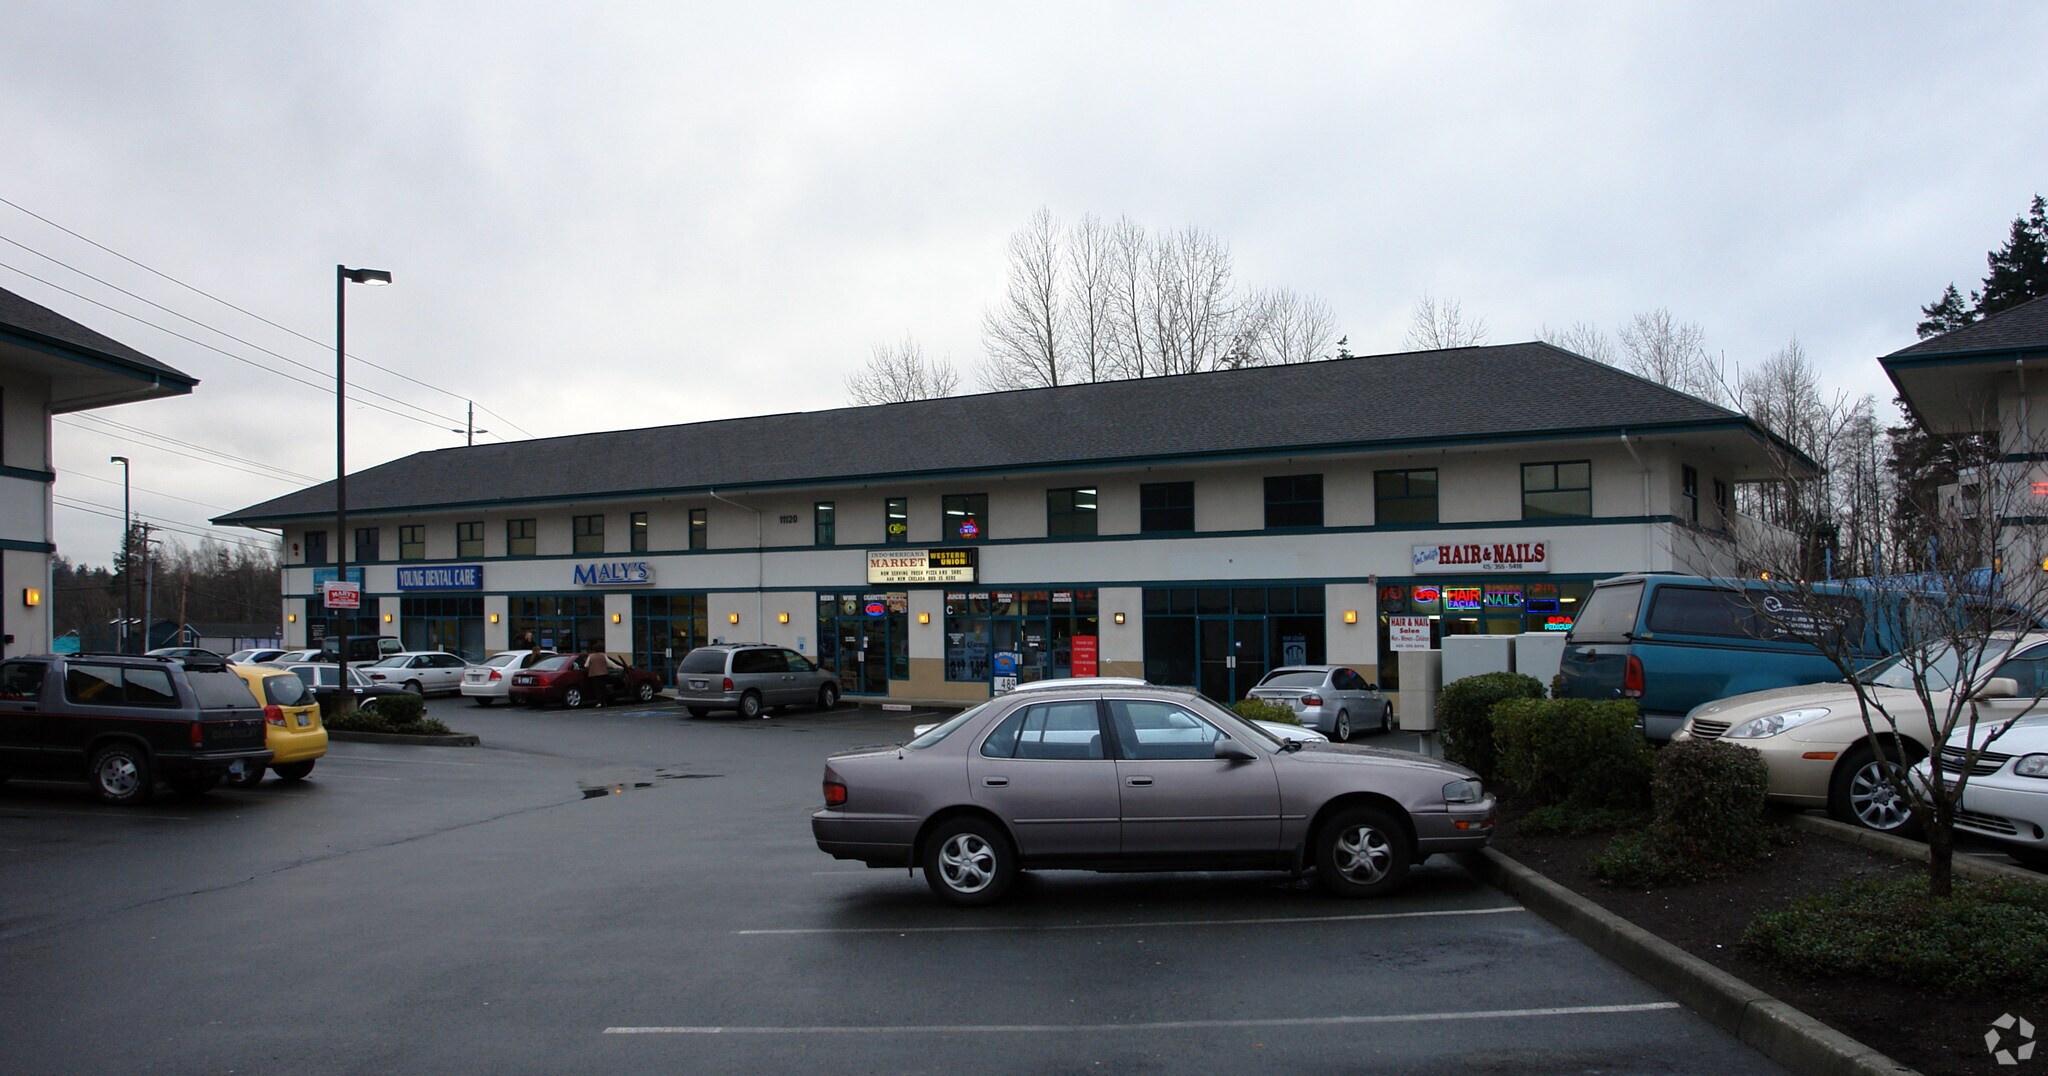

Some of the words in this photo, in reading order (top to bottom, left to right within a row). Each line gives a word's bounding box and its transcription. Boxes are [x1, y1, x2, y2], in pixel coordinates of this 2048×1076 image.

[779, 514, 798, 524] 11120
[1438, 544, 1482, 565] HAIR
[1483, 546, 1492, 561] &
[1493, 543, 1546, 564] NAILS
[870, 558, 926, 568] MARKET
[940, 558, 966, 566] UNION
[399, 570, 424, 586] YOUNG
[425, 569, 453, 586] DENTAL
[454, 569, 475, 585] CARE
[573, 561, 647, 584] MALY'S
[1414, 590, 1439, 600] OPEN
[1447, 589, 1480, 602] HAIR
[1487, 593, 1520, 606] NAILS
[946, 605, 954, 615] C
[1391, 617, 1406, 627] HAIR
[1407, 617, 1413, 627] &
[1414, 617, 1429, 627] NAIL
[1547, 616, 1573, 624] SPA
